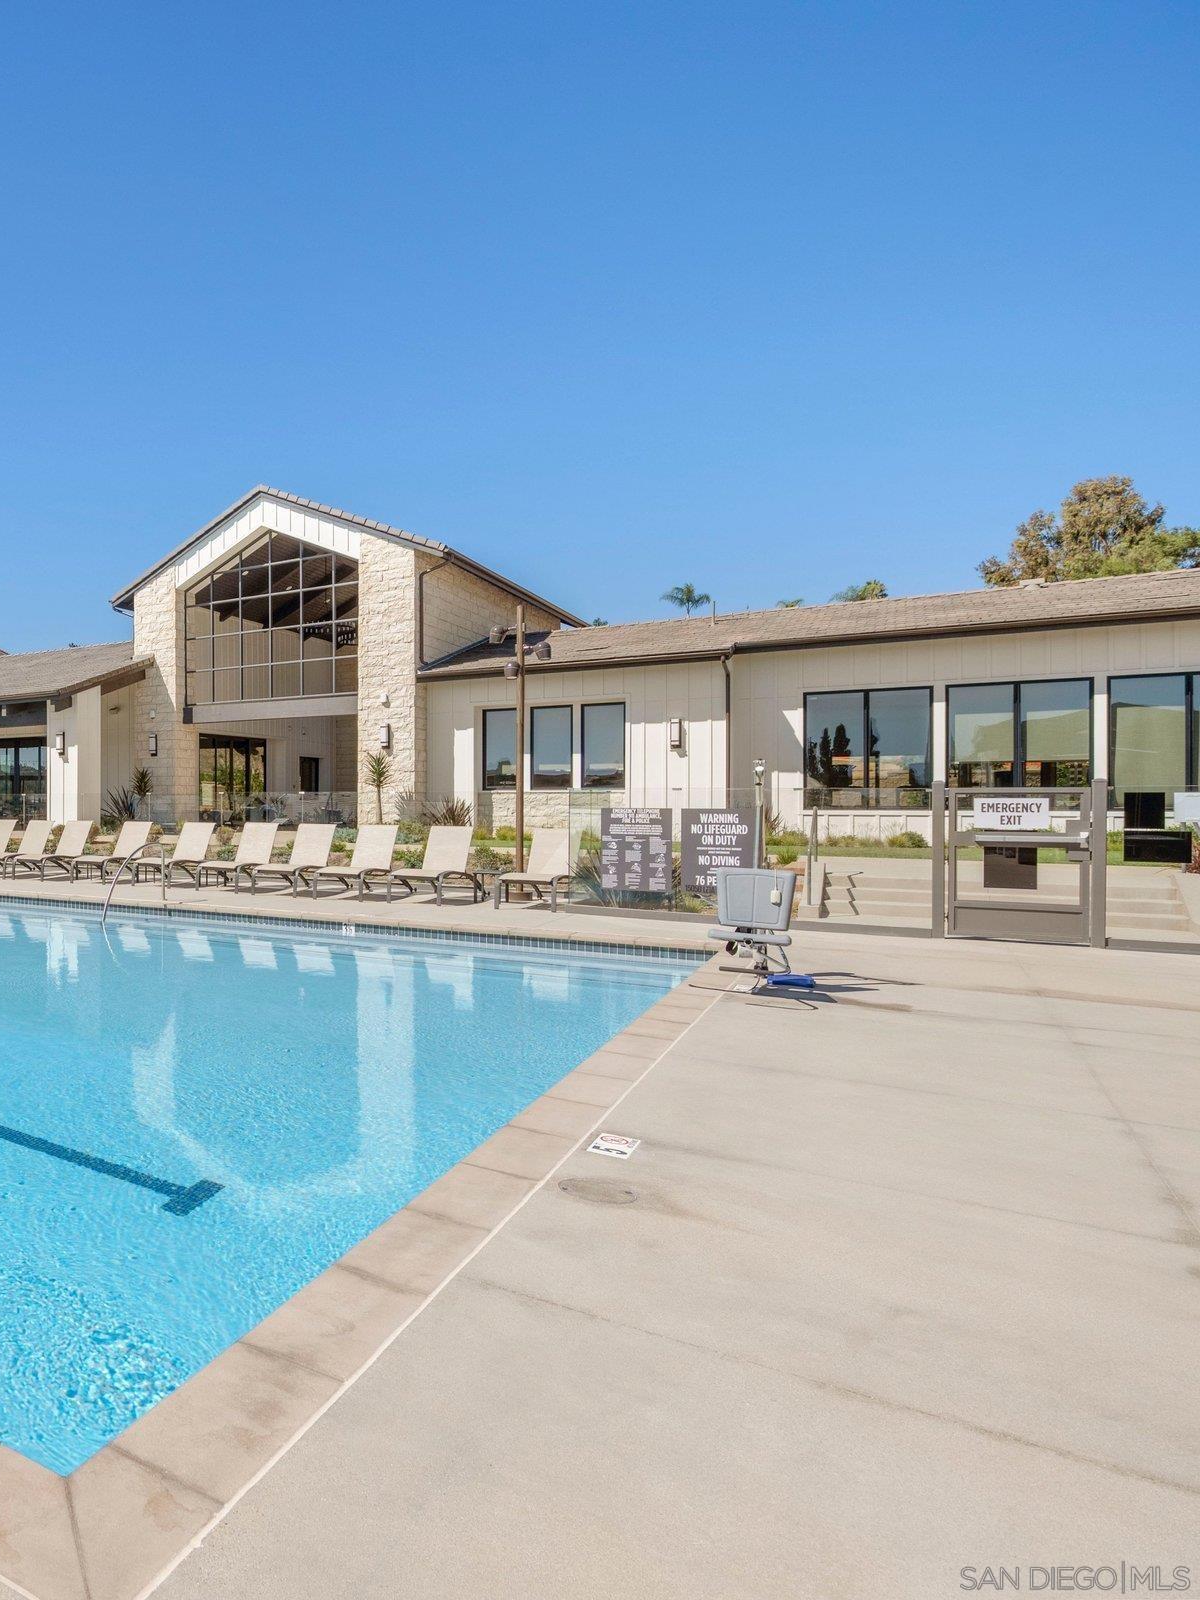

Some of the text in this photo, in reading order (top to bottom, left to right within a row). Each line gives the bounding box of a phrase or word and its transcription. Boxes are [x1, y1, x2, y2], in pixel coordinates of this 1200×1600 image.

[981, 802, 1042, 813] EMERGENCY
[700, 813, 739, 824] WARNING
[1000, 815, 1022, 825] EXIT
[691, 824, 748, 835] NO LIFEGUARD
[702, 835, 737, 846] ON DUTY
[698, 855, 740, 867] NO DIVING
[695, 875, 705, 886] 76
